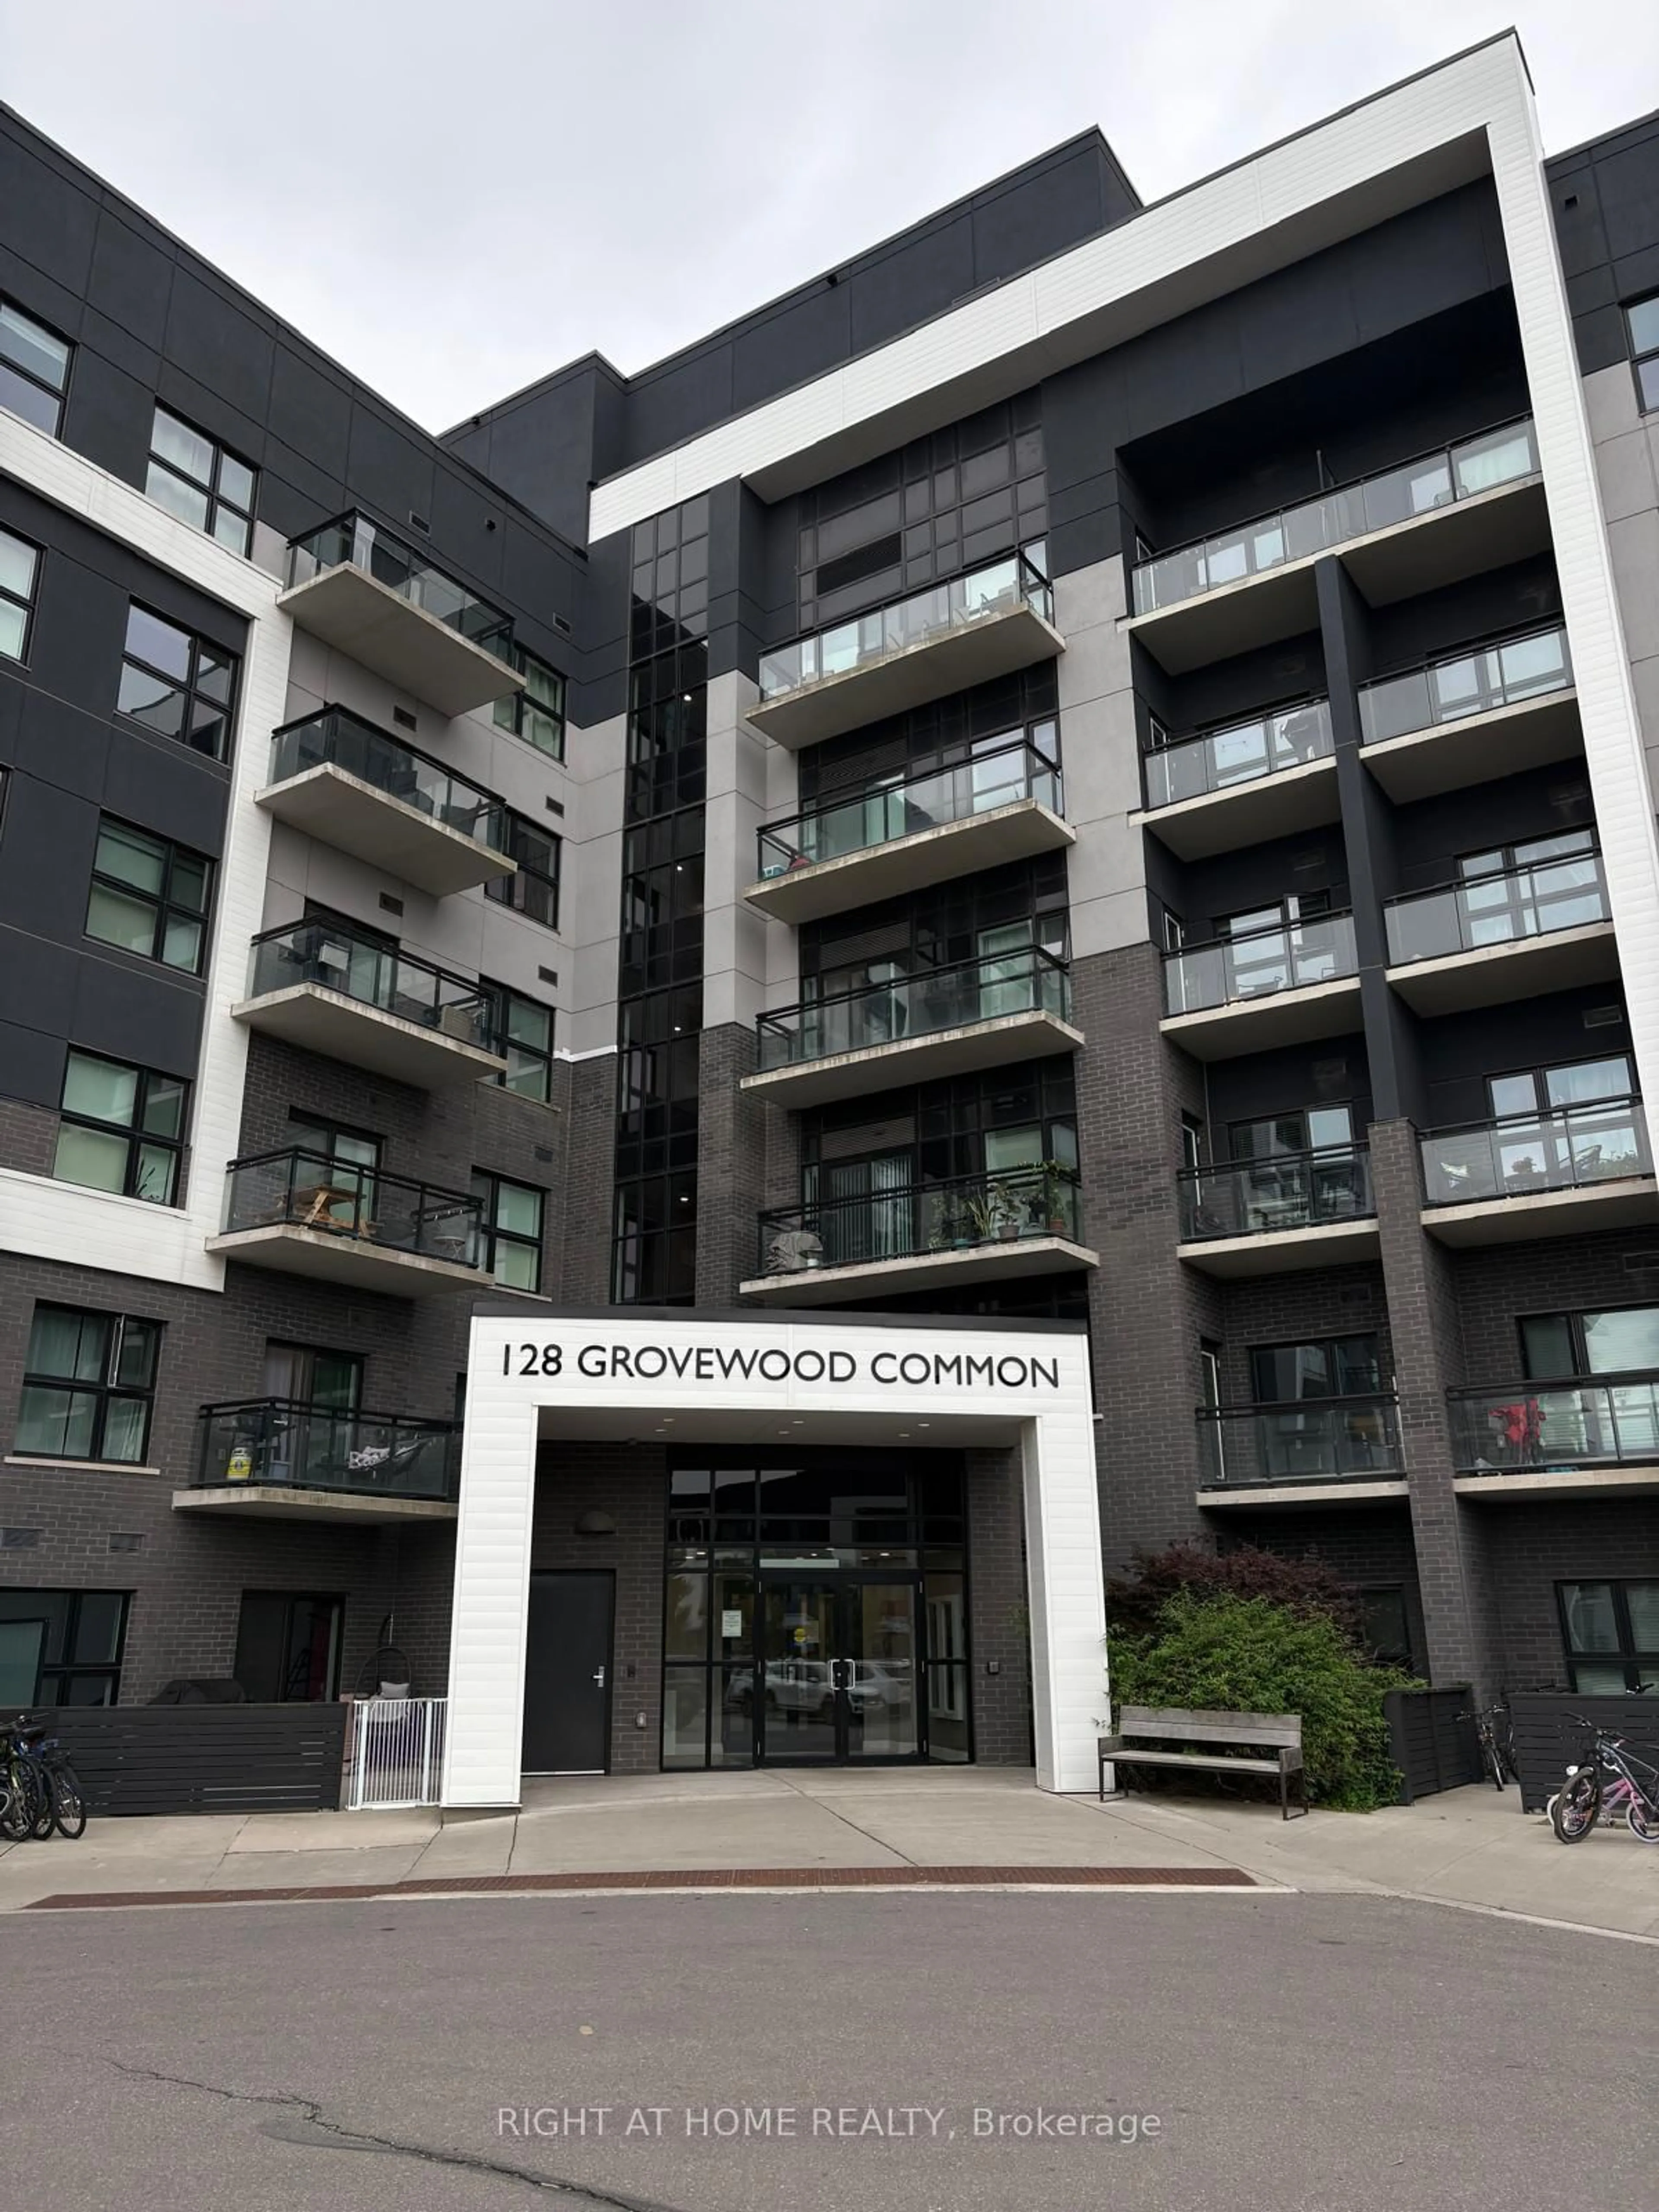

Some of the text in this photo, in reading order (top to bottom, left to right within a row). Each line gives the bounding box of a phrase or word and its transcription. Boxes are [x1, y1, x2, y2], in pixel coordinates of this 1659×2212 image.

[503, 1343, 1059, 1389] 128 GROVEWOOD COMMON
